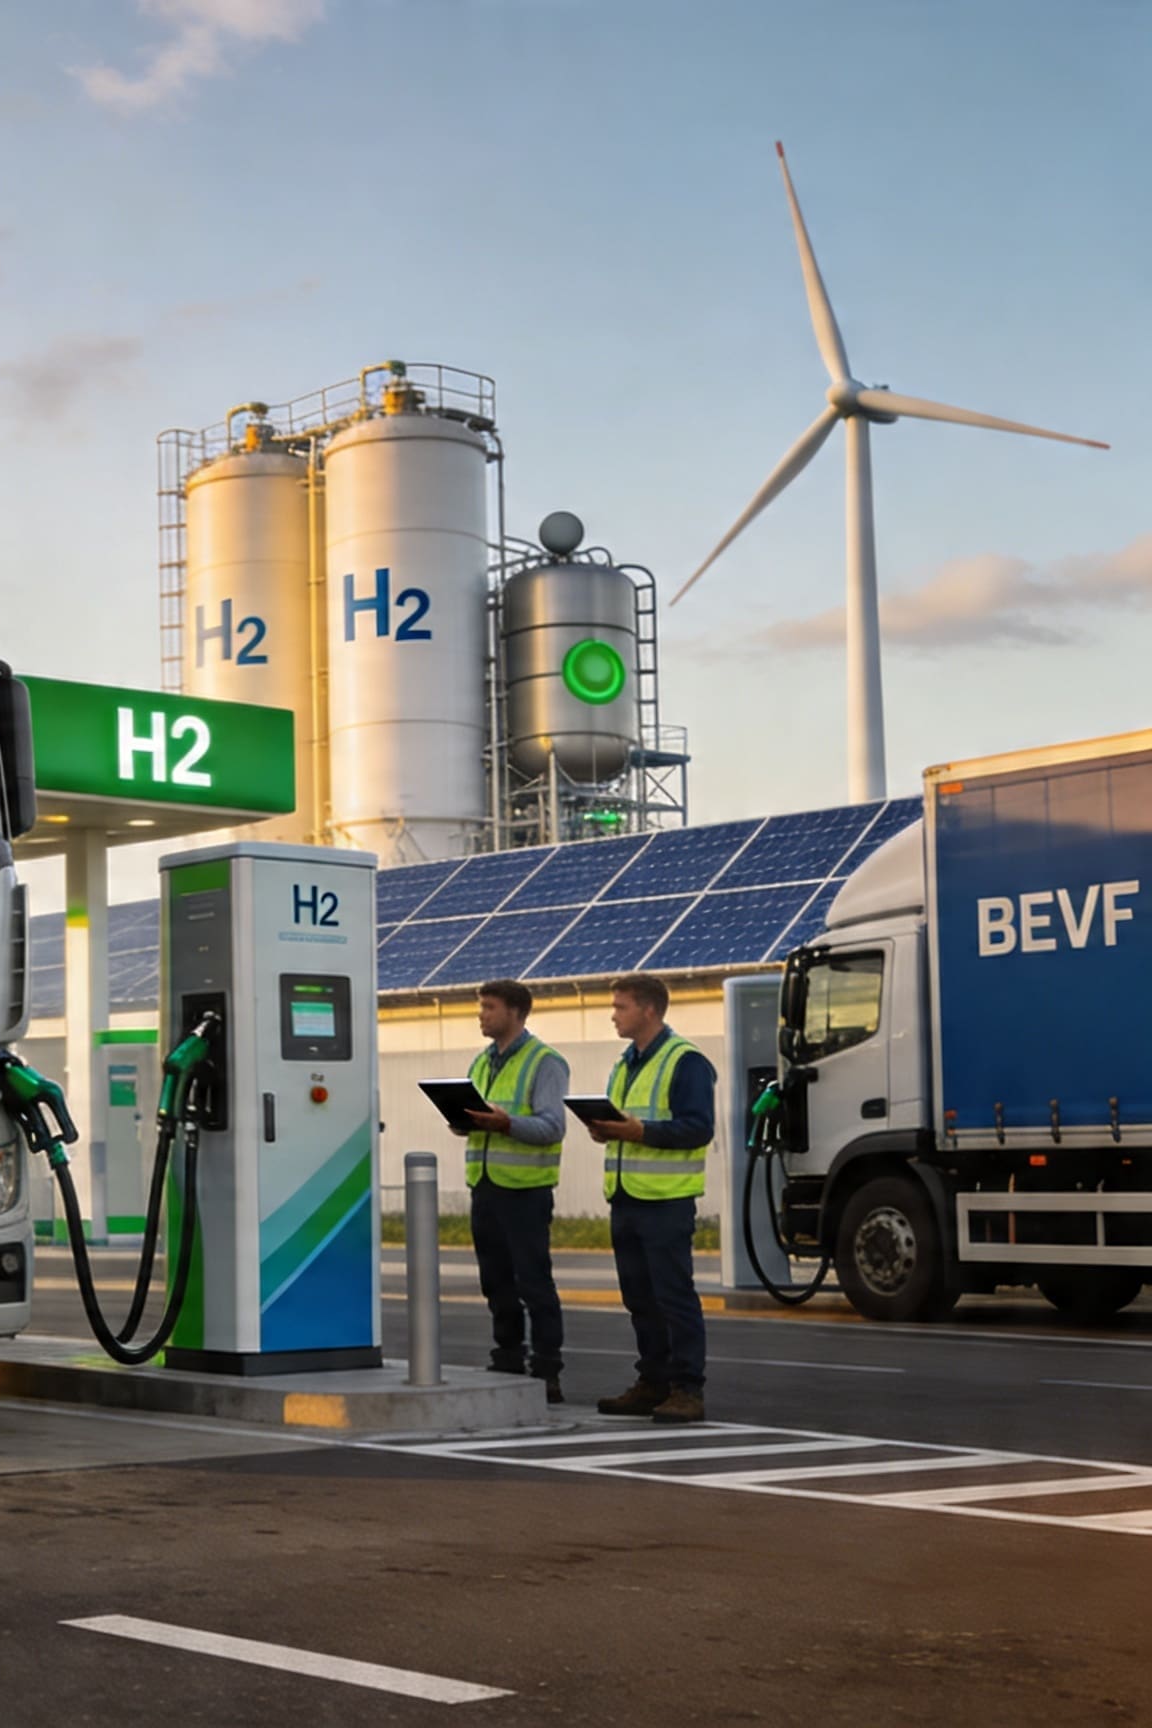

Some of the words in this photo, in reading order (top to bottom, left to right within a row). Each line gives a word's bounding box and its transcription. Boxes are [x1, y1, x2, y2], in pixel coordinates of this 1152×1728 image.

[195, 598, 268, 668] H2
[343, 568, 432, 642] H2
[117, 706, 212, 787] H2
[293, 884, 339, 927] H2
[977, 879, 1140, 957] BEVF
